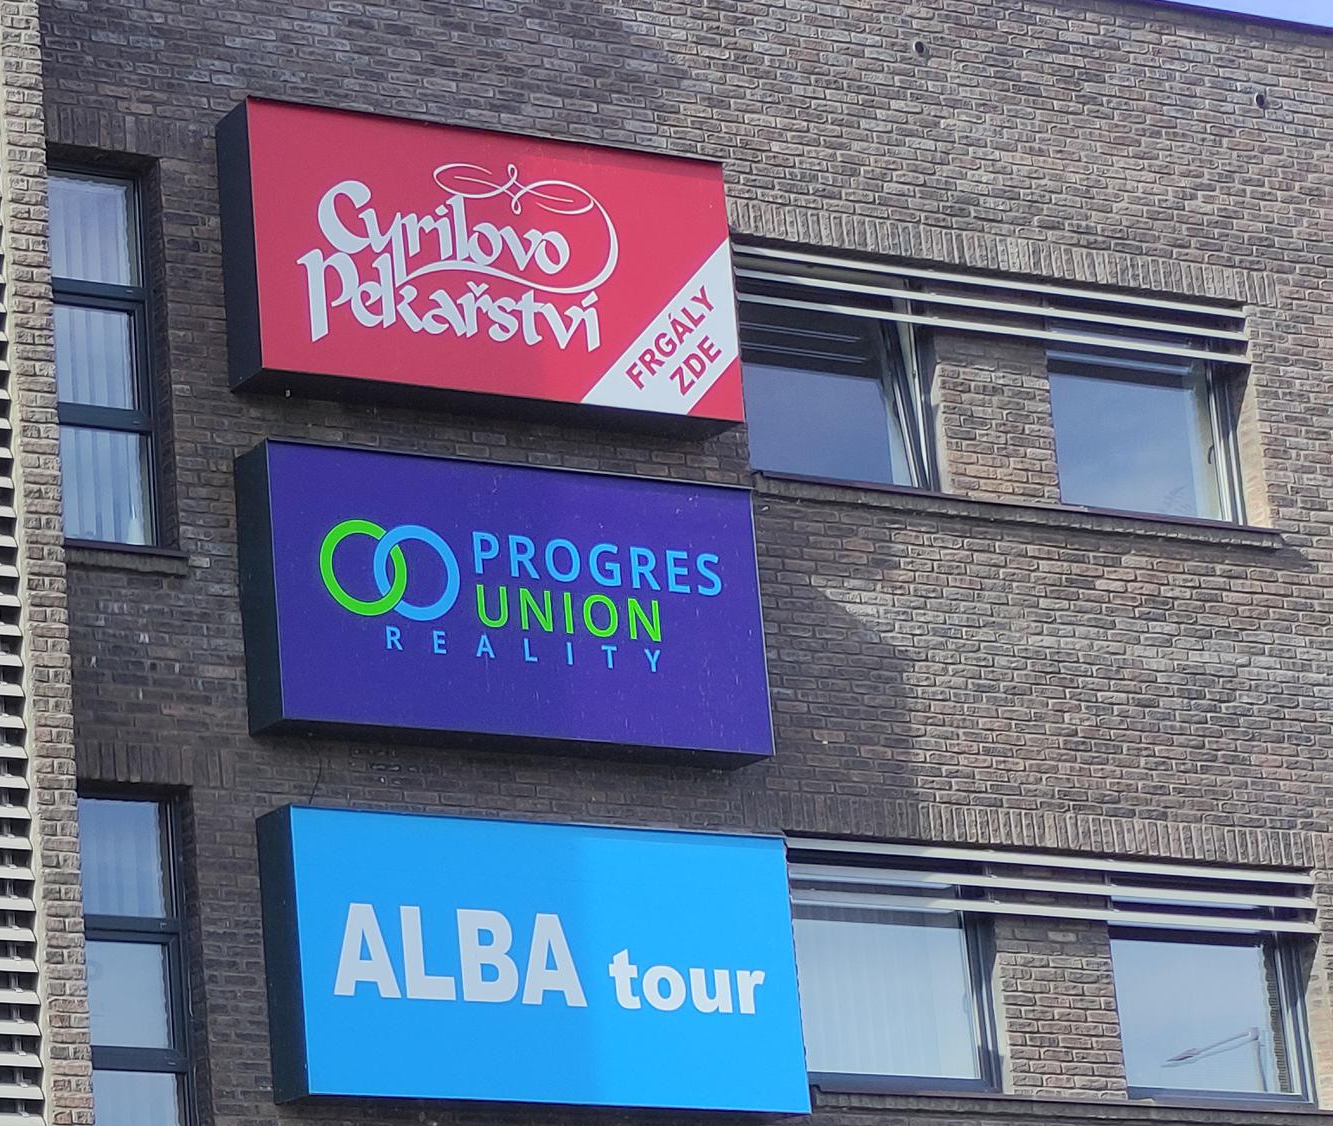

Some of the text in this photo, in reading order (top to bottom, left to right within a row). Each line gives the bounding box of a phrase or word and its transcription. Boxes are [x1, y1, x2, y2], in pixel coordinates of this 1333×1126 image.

[317, 172, 579, 285] Cyrilovo
[297, 247, 601, 352] Pekařství
[624, 284, 717, 390] FRGÁLY
[668, 334, 723, 397] ZDE
[472, 530, 723, 596] PROGRES
[386, 625, 663, 674] REALITY
[476, 583, 663, 643] UNION
[333, 901, 767, 1016] ALBA tour
